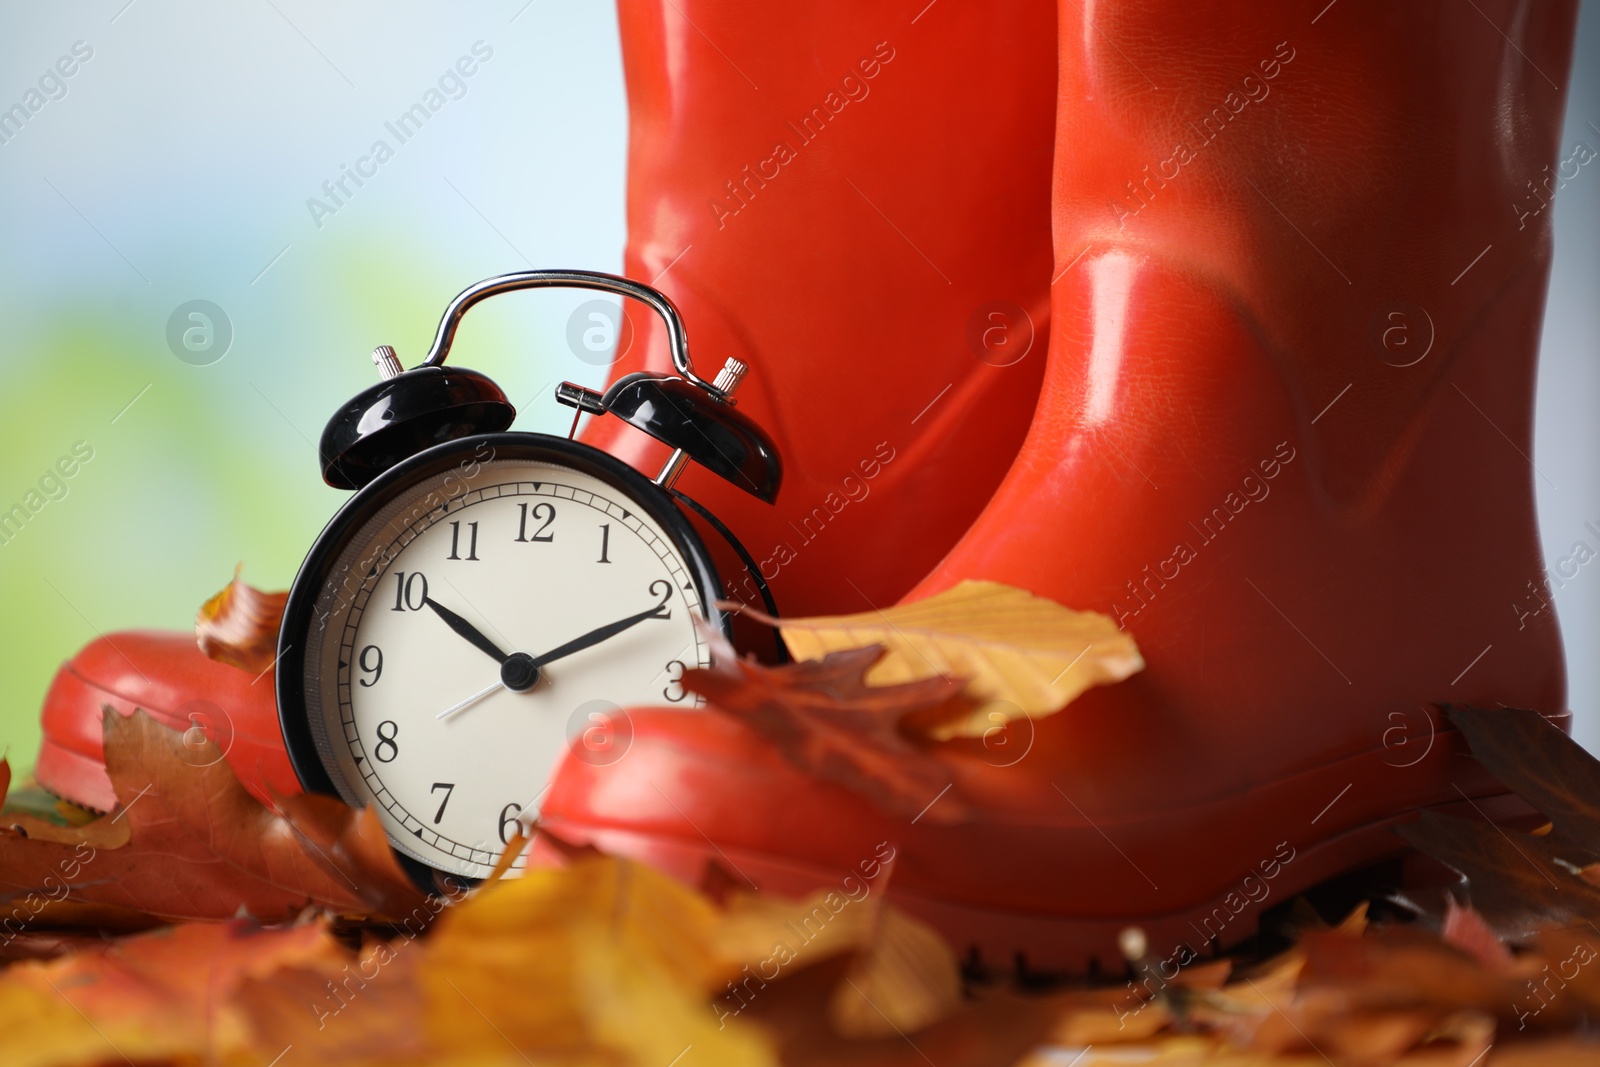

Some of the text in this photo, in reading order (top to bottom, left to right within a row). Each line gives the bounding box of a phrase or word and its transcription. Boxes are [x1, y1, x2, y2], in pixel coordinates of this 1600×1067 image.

[446, 520, 480, 561] 11
[514, 502, 556, 543] 12
[596, 524, 613, 564] 1
[391, 571, 429, 611] 10
[648, 579, 673, 620] 2
[359, 645, 384, 687] 9
[662, 660, 689, 702] 3
[374, 720, 399, 763] 8
[431, 782, 455, 824] 7
[498, 803, 524, 847] 6
